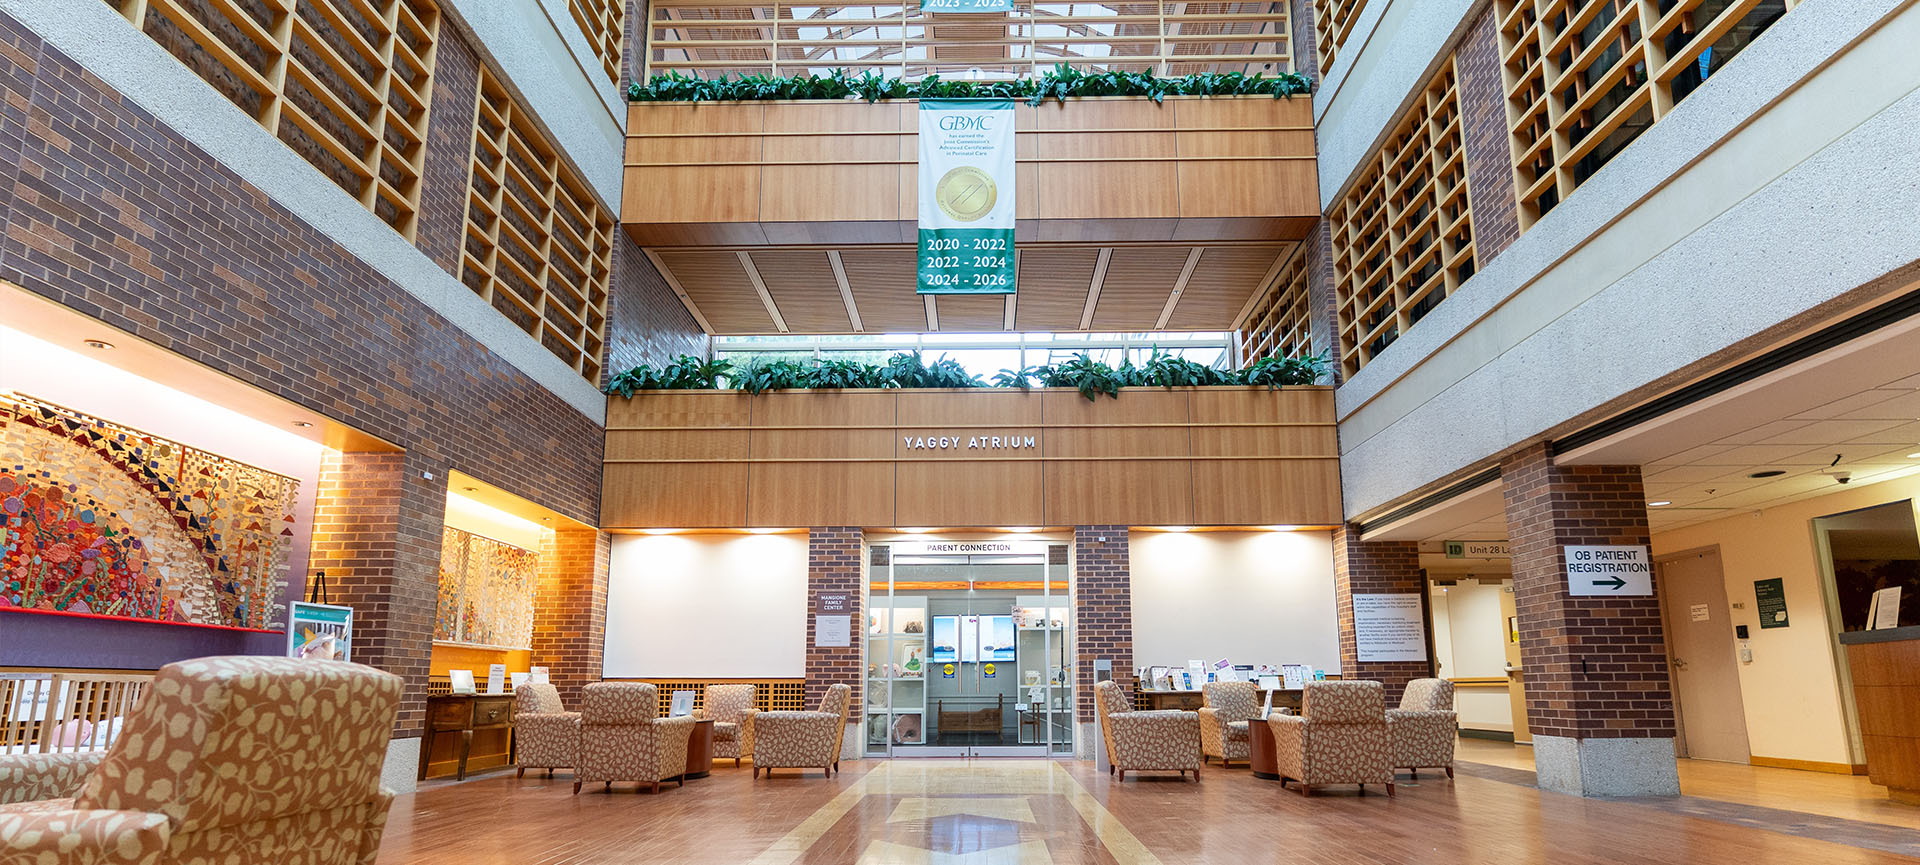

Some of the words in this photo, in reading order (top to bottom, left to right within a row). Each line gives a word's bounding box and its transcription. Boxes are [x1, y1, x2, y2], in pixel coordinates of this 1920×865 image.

[939, 115, 995, 131] GBMC
[927, 239, 960, 251] 2020
[973, 238, 1006, 250] 2022
[927, 256, 960, 268] 2022
[973, 256, 1006, 268] 2024
[926, 274, 960, 286] 2024
[973, 273, 1006, 286] 2026
[904, 436, 960, 449] YAGGY
[968, 436, 1035, 449] ATRIUM
[1470, 546, 1488, 554] Unit
[1489, 546, 1500, 554] 28
[1575, 551, 1591, 560] OB
[1595, 550, 1638, 560] PATIENT
[1568, 563, 1648, 573] REGISTRATION
